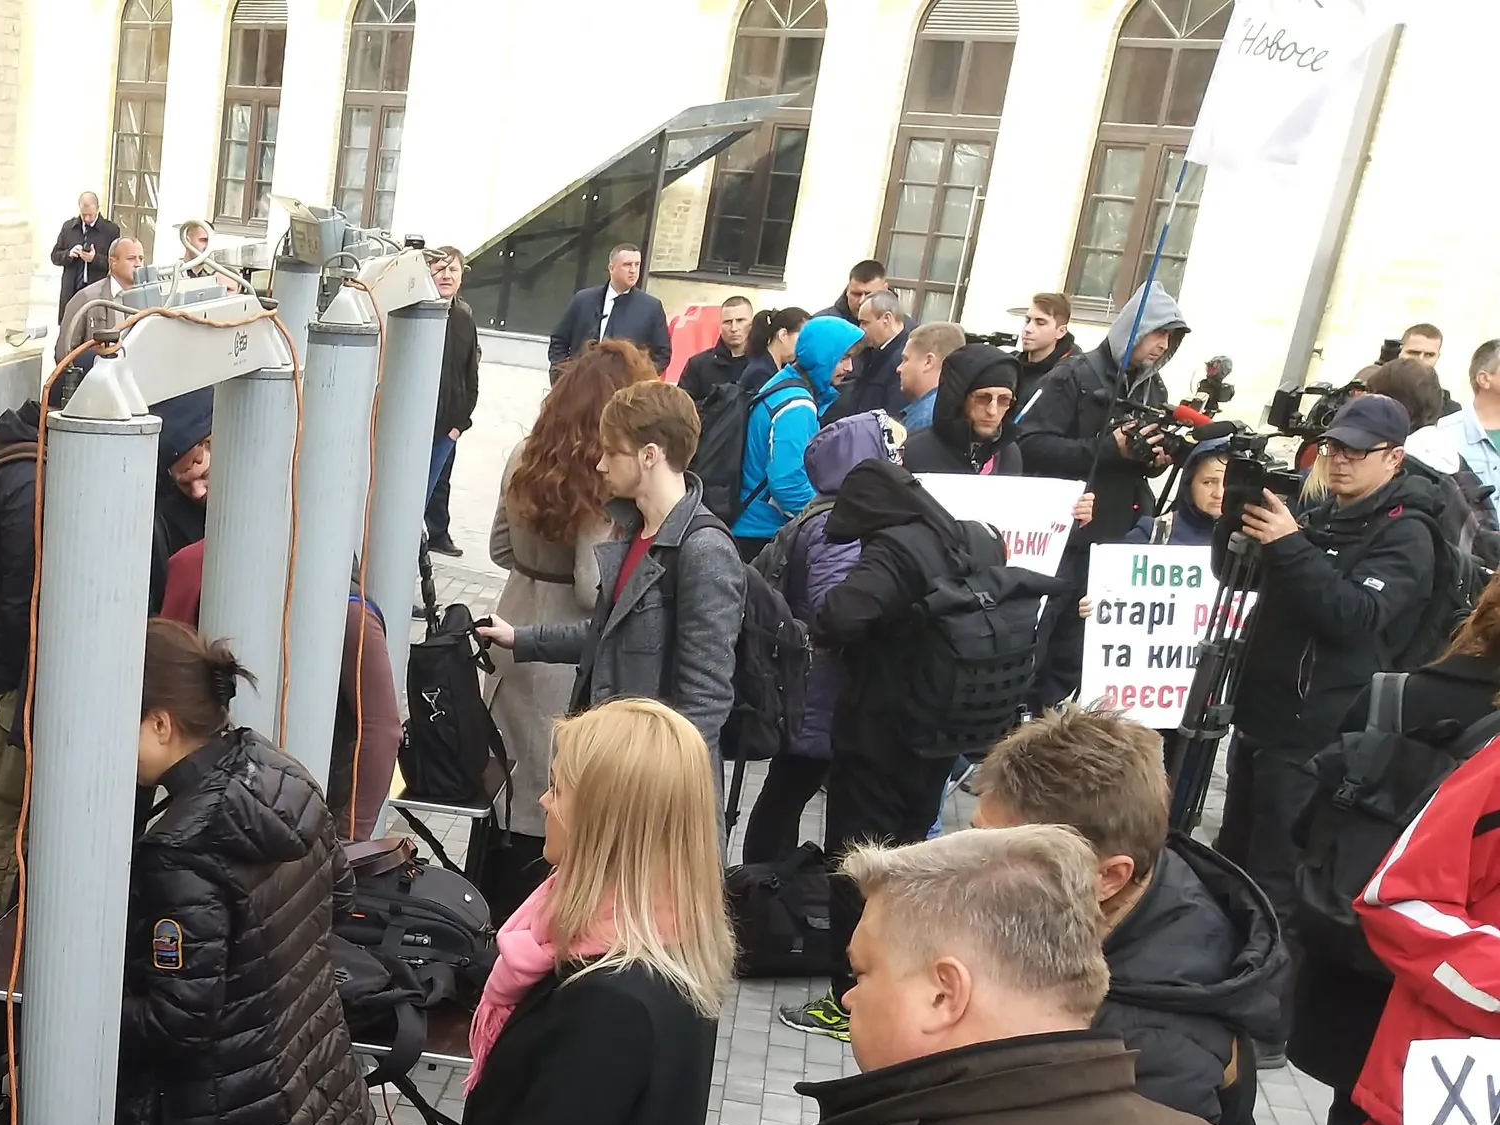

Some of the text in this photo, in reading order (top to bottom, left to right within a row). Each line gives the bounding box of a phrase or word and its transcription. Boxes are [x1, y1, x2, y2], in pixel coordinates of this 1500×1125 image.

[1131, 554, 1202, 588] Нова
[1096, 593, 1176, 635] старі
[1101, 644, 1132, 668] та
